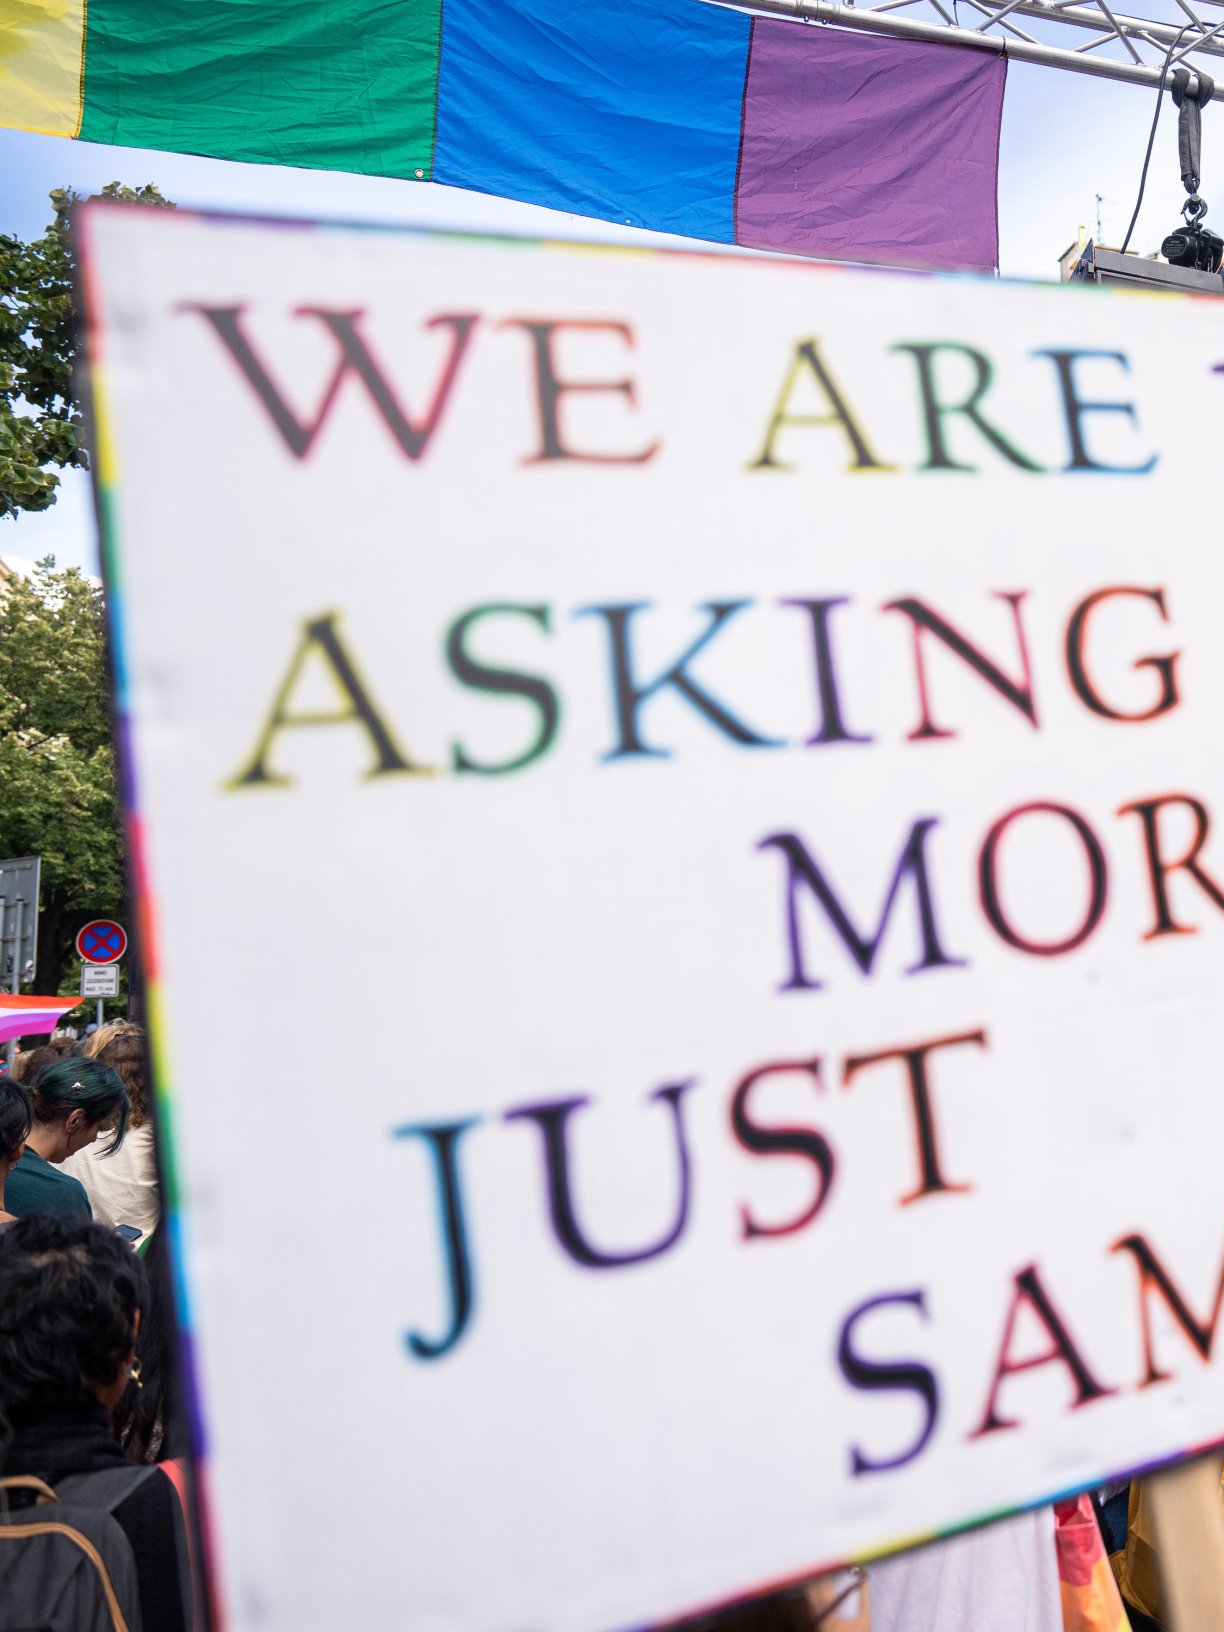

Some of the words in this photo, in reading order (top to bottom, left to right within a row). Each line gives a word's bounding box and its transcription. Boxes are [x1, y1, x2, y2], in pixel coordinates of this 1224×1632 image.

[174, 299, 660, 466] WE
[744, 335, 1160, 477] ARE
[222, 584, 1182, 794] ASKING
[389, 1025, 990, 1367] JUST
